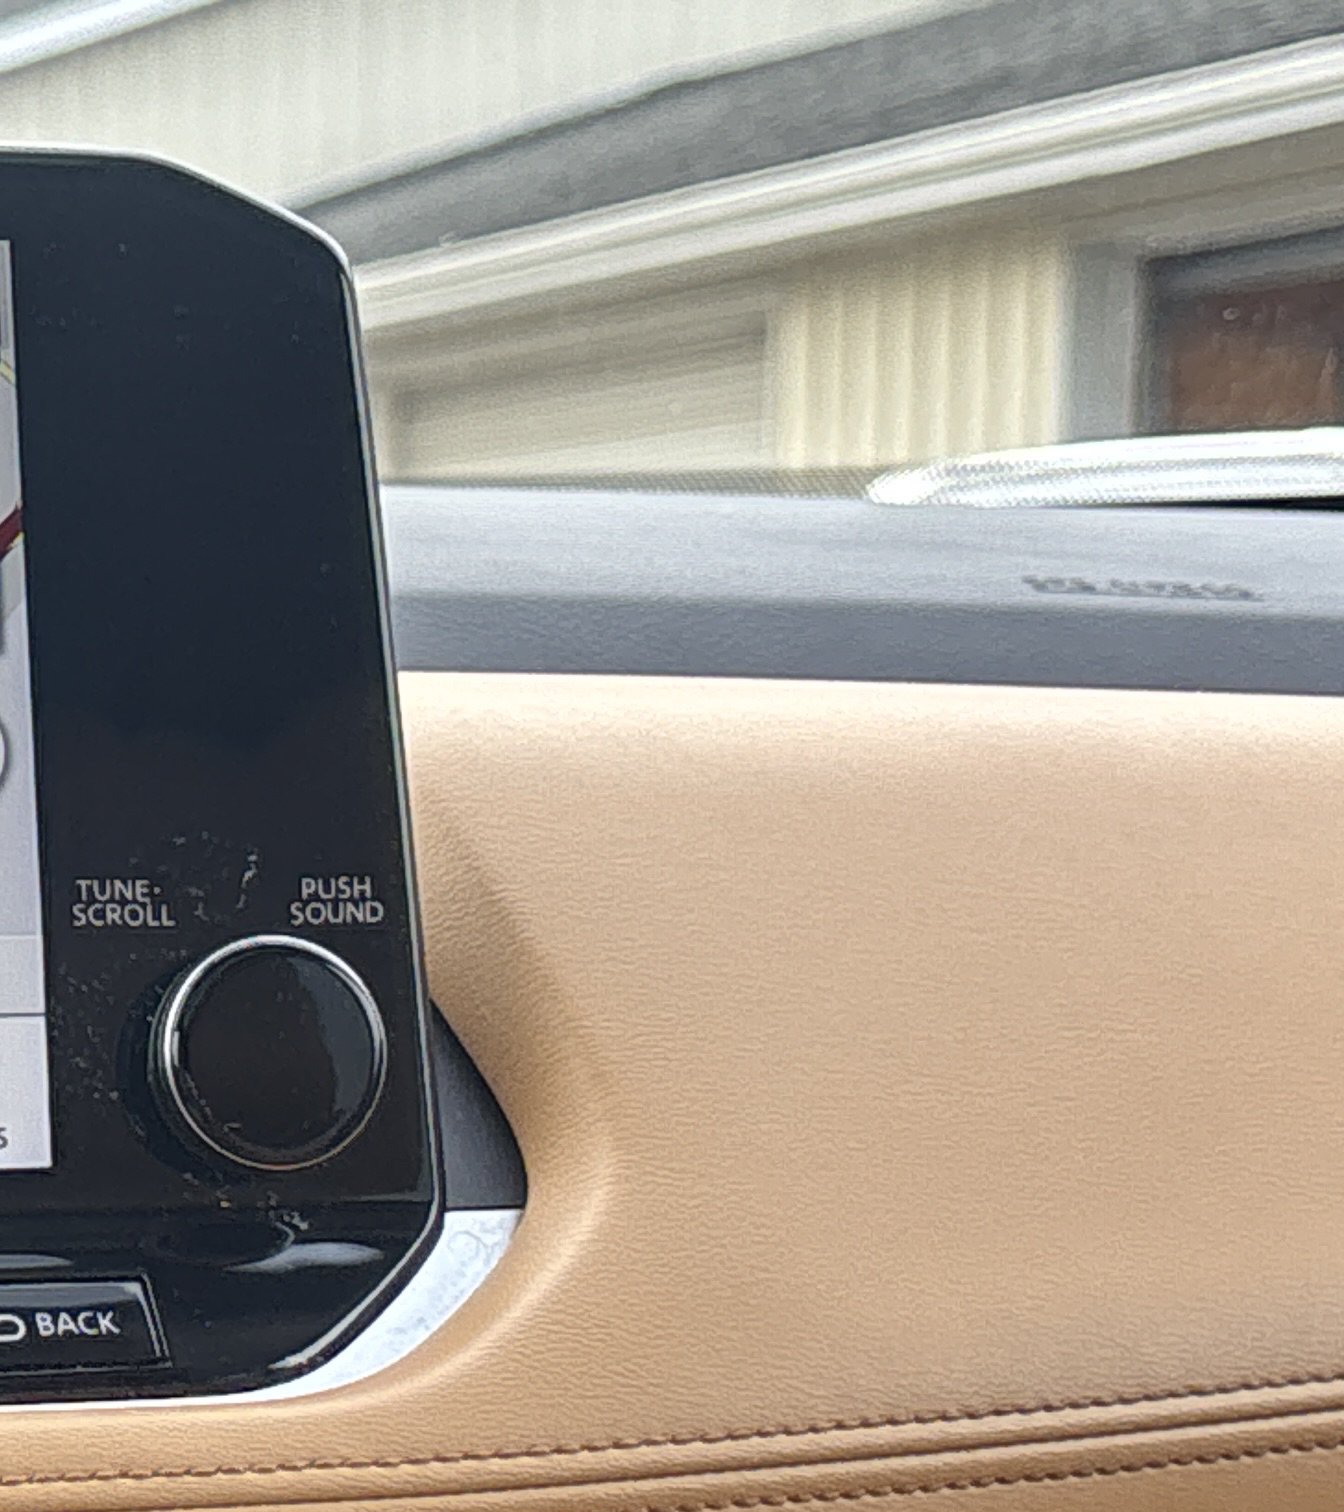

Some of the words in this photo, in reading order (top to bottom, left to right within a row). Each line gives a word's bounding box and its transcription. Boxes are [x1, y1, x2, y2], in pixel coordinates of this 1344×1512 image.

[301, 876, 372, 900] PUSH
[72, 903, 176, 927] SCROLL
[290, 900, 384, 926] SOUND
[35, 1311, 120, 1337] BACK
